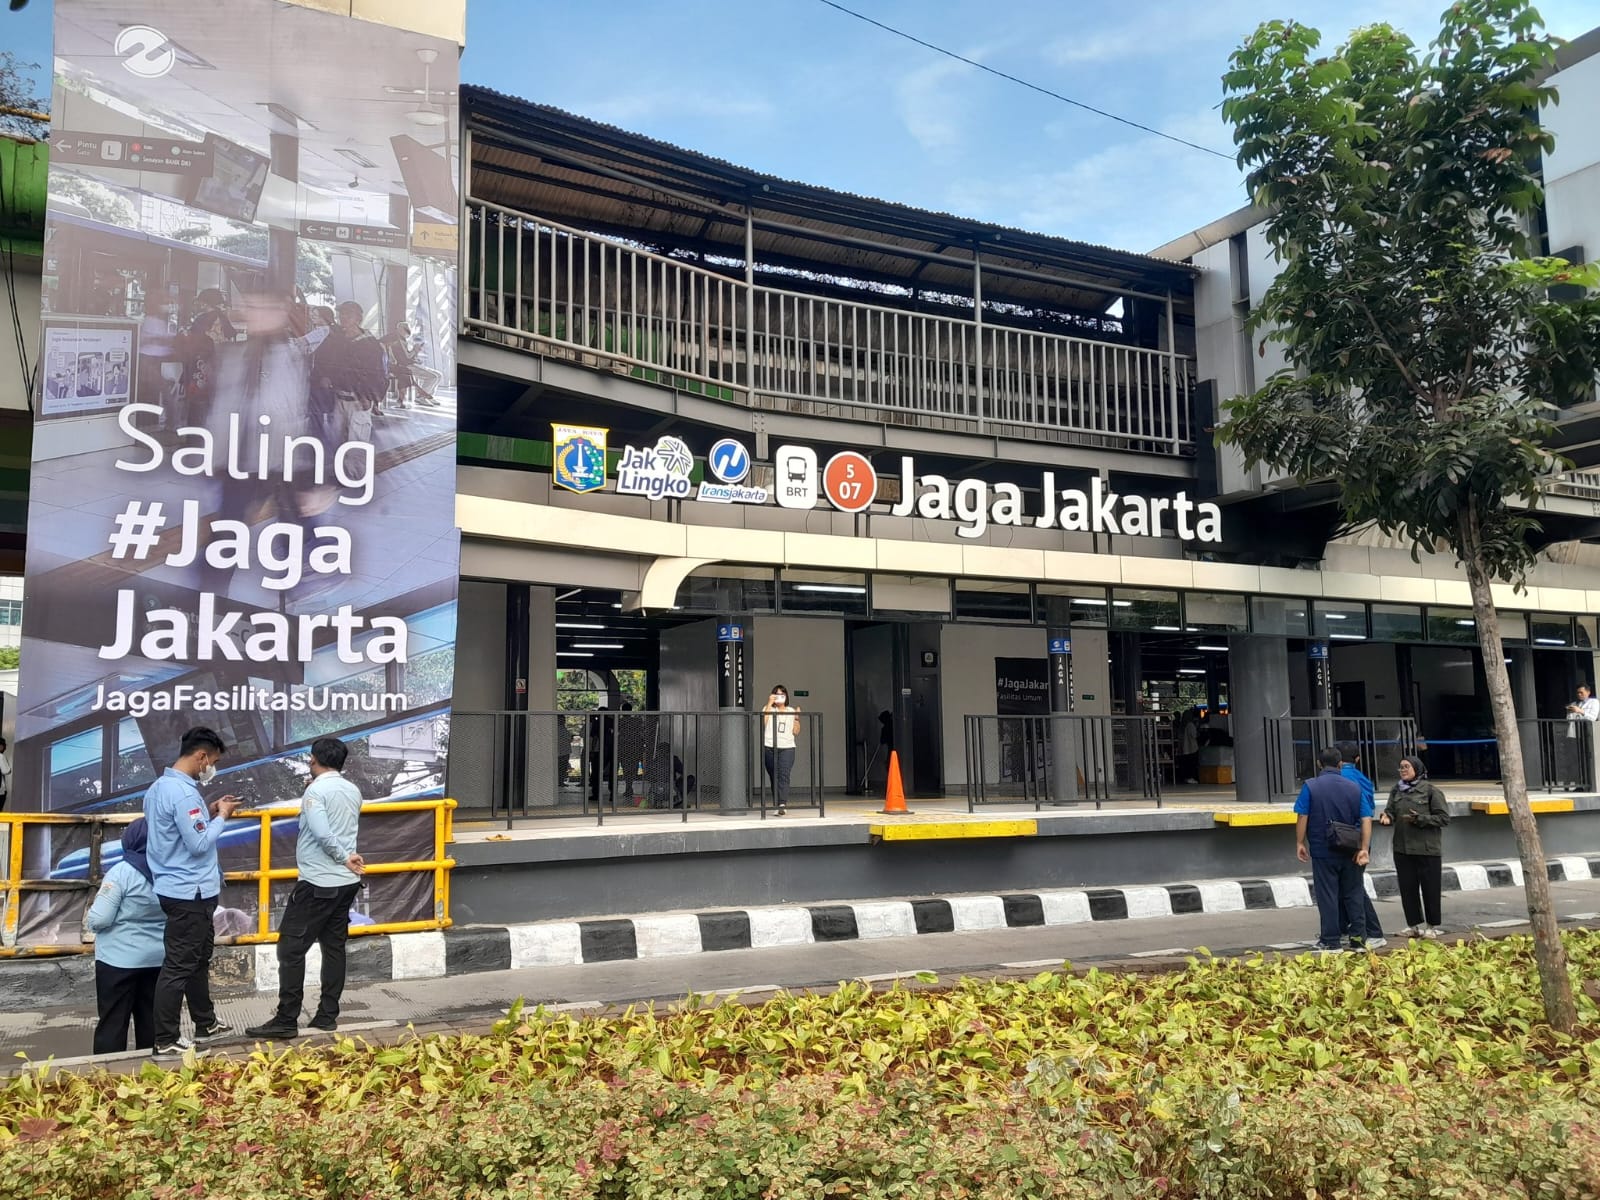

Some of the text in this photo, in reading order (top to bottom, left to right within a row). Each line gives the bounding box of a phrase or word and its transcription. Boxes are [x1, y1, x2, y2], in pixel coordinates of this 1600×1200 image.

[114, 402, 376, 506] Saling
[621, 448, 657, 471] Jak
[620, 471, 689, 497] Lingko
[845, 464, 855, 479] 5
[701, 483, 766, 502] transjakarta
[786, 486, 809, 498] BRT
[838, 481, 862, 500] 07
[891, 455, 1223, 543] Jaga Jakarta
[108, 499, 352, 590] #Jaga
[98, 589, 408, 664] Jakarta
[91, 684, 408, 717] JagaFasilitasUmum
